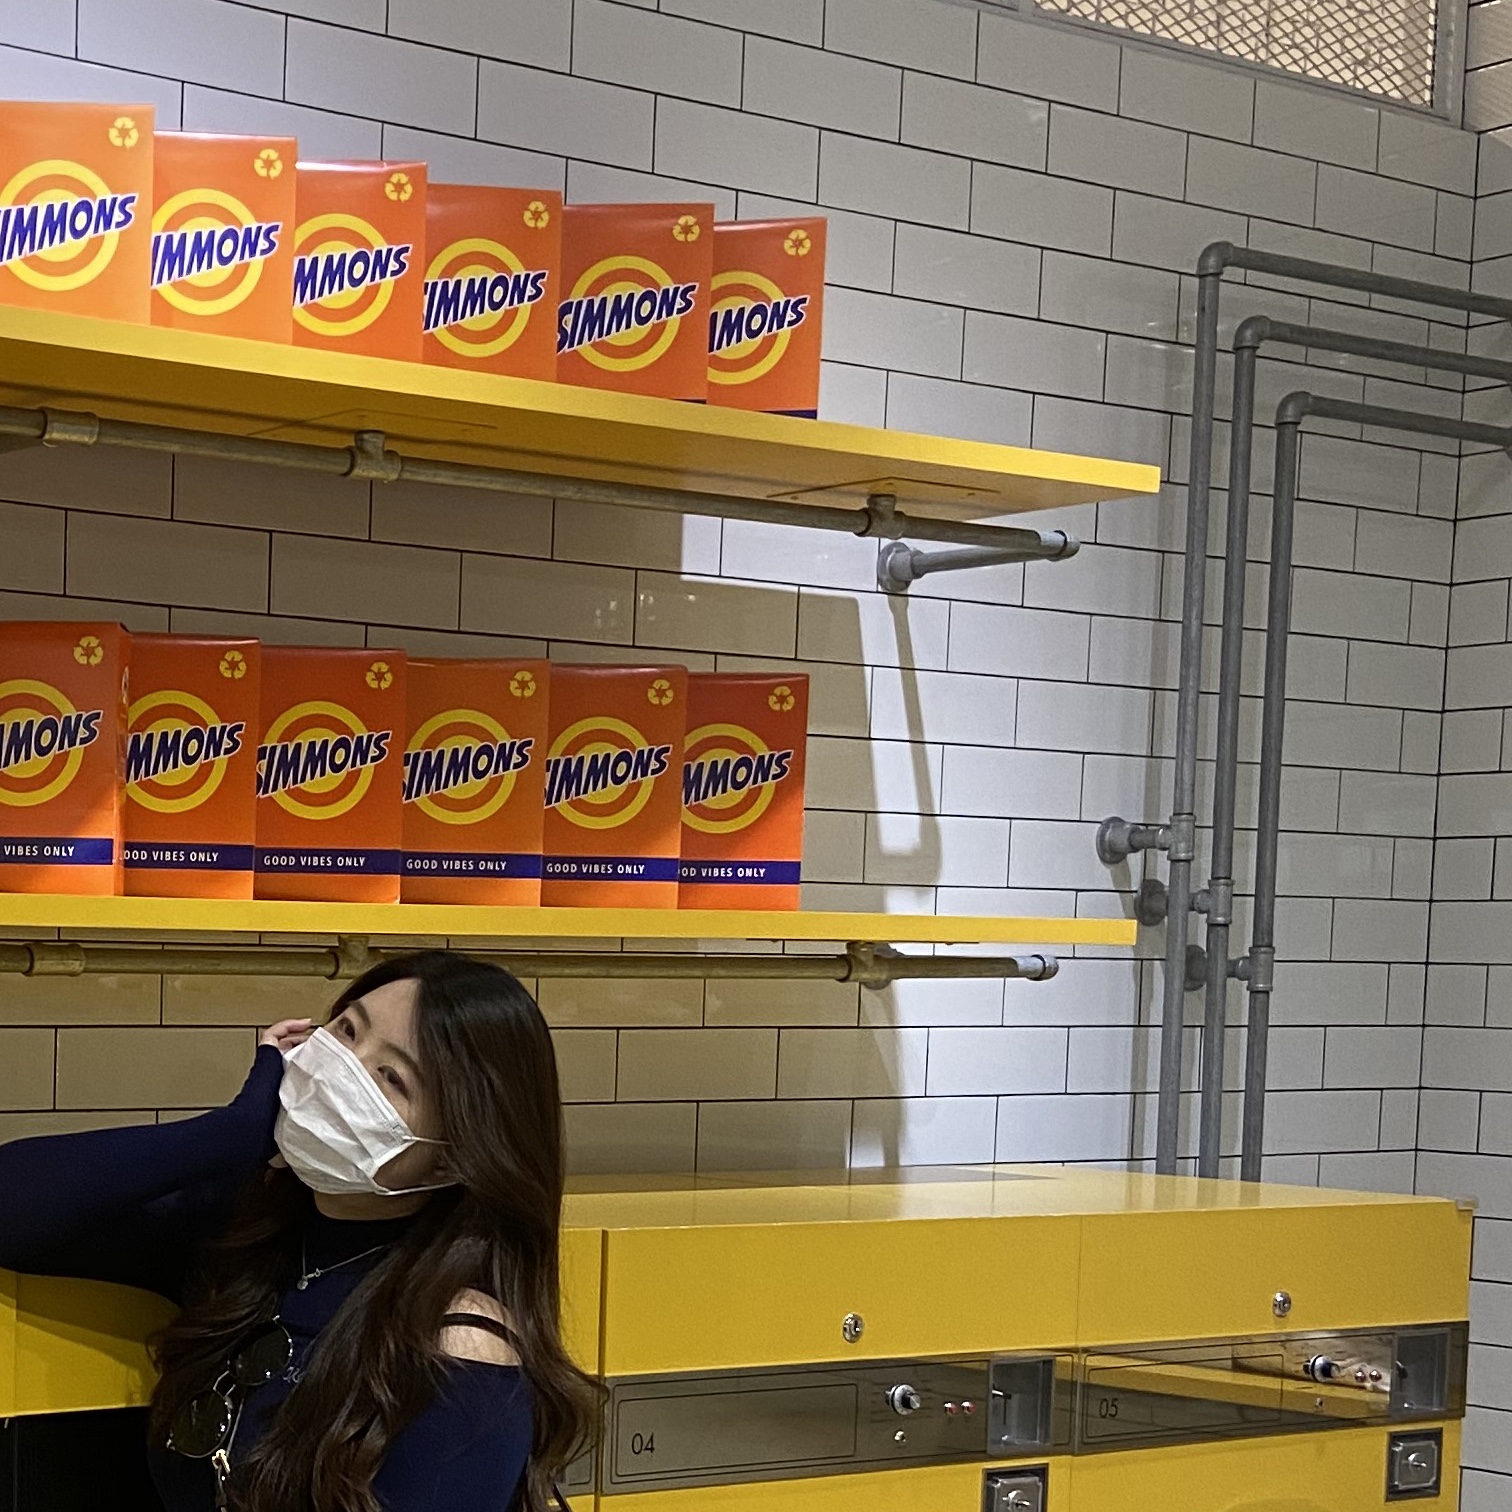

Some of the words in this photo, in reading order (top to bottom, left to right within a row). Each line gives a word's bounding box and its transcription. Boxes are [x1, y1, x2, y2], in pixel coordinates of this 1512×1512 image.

[150, 222, 280, 288] IMMONS
[294, 246, 410, 306] MMONS
[424, 272, 548, 332] IMMONS
[708, 297, 808, 354] MONS
[126, 722, 244, 784] MMONS
[402, 738, 533, 803] IMMONS
[545, 744, 672, 809] IMMONS
[684, 749, 793, 807] MMONS
[4, 845, 38, 856] VIBES
[44, 846, 75, 857] ONLY
[121, 850, 148, 861] OOD
[152, 850, 185, 862] VIBES
[190, 852, 219, 862] ONLY
[264, 855, 296, 866] GOOD
[300, 856, 333, 866] VIBES
[337, 856, 366, 867] ONLY
[406, 859, 438, 870] GOOD
[442, 860, 474, 870] VIBES
[479, 861, 507, 871] ONLY
[546, 862, 577, 873] GOOD
[582, 864, 613, 874] VIBES
[617, 864, 645, 874] ONLY
[679, 867, 696, 877] OD
[701, 868, 733, 878] VIBES
[737, 868, 766, 878] ONLY
[1099, 1397, 1119, 1419] 05
[631, 1432, 655, 1455] 04
